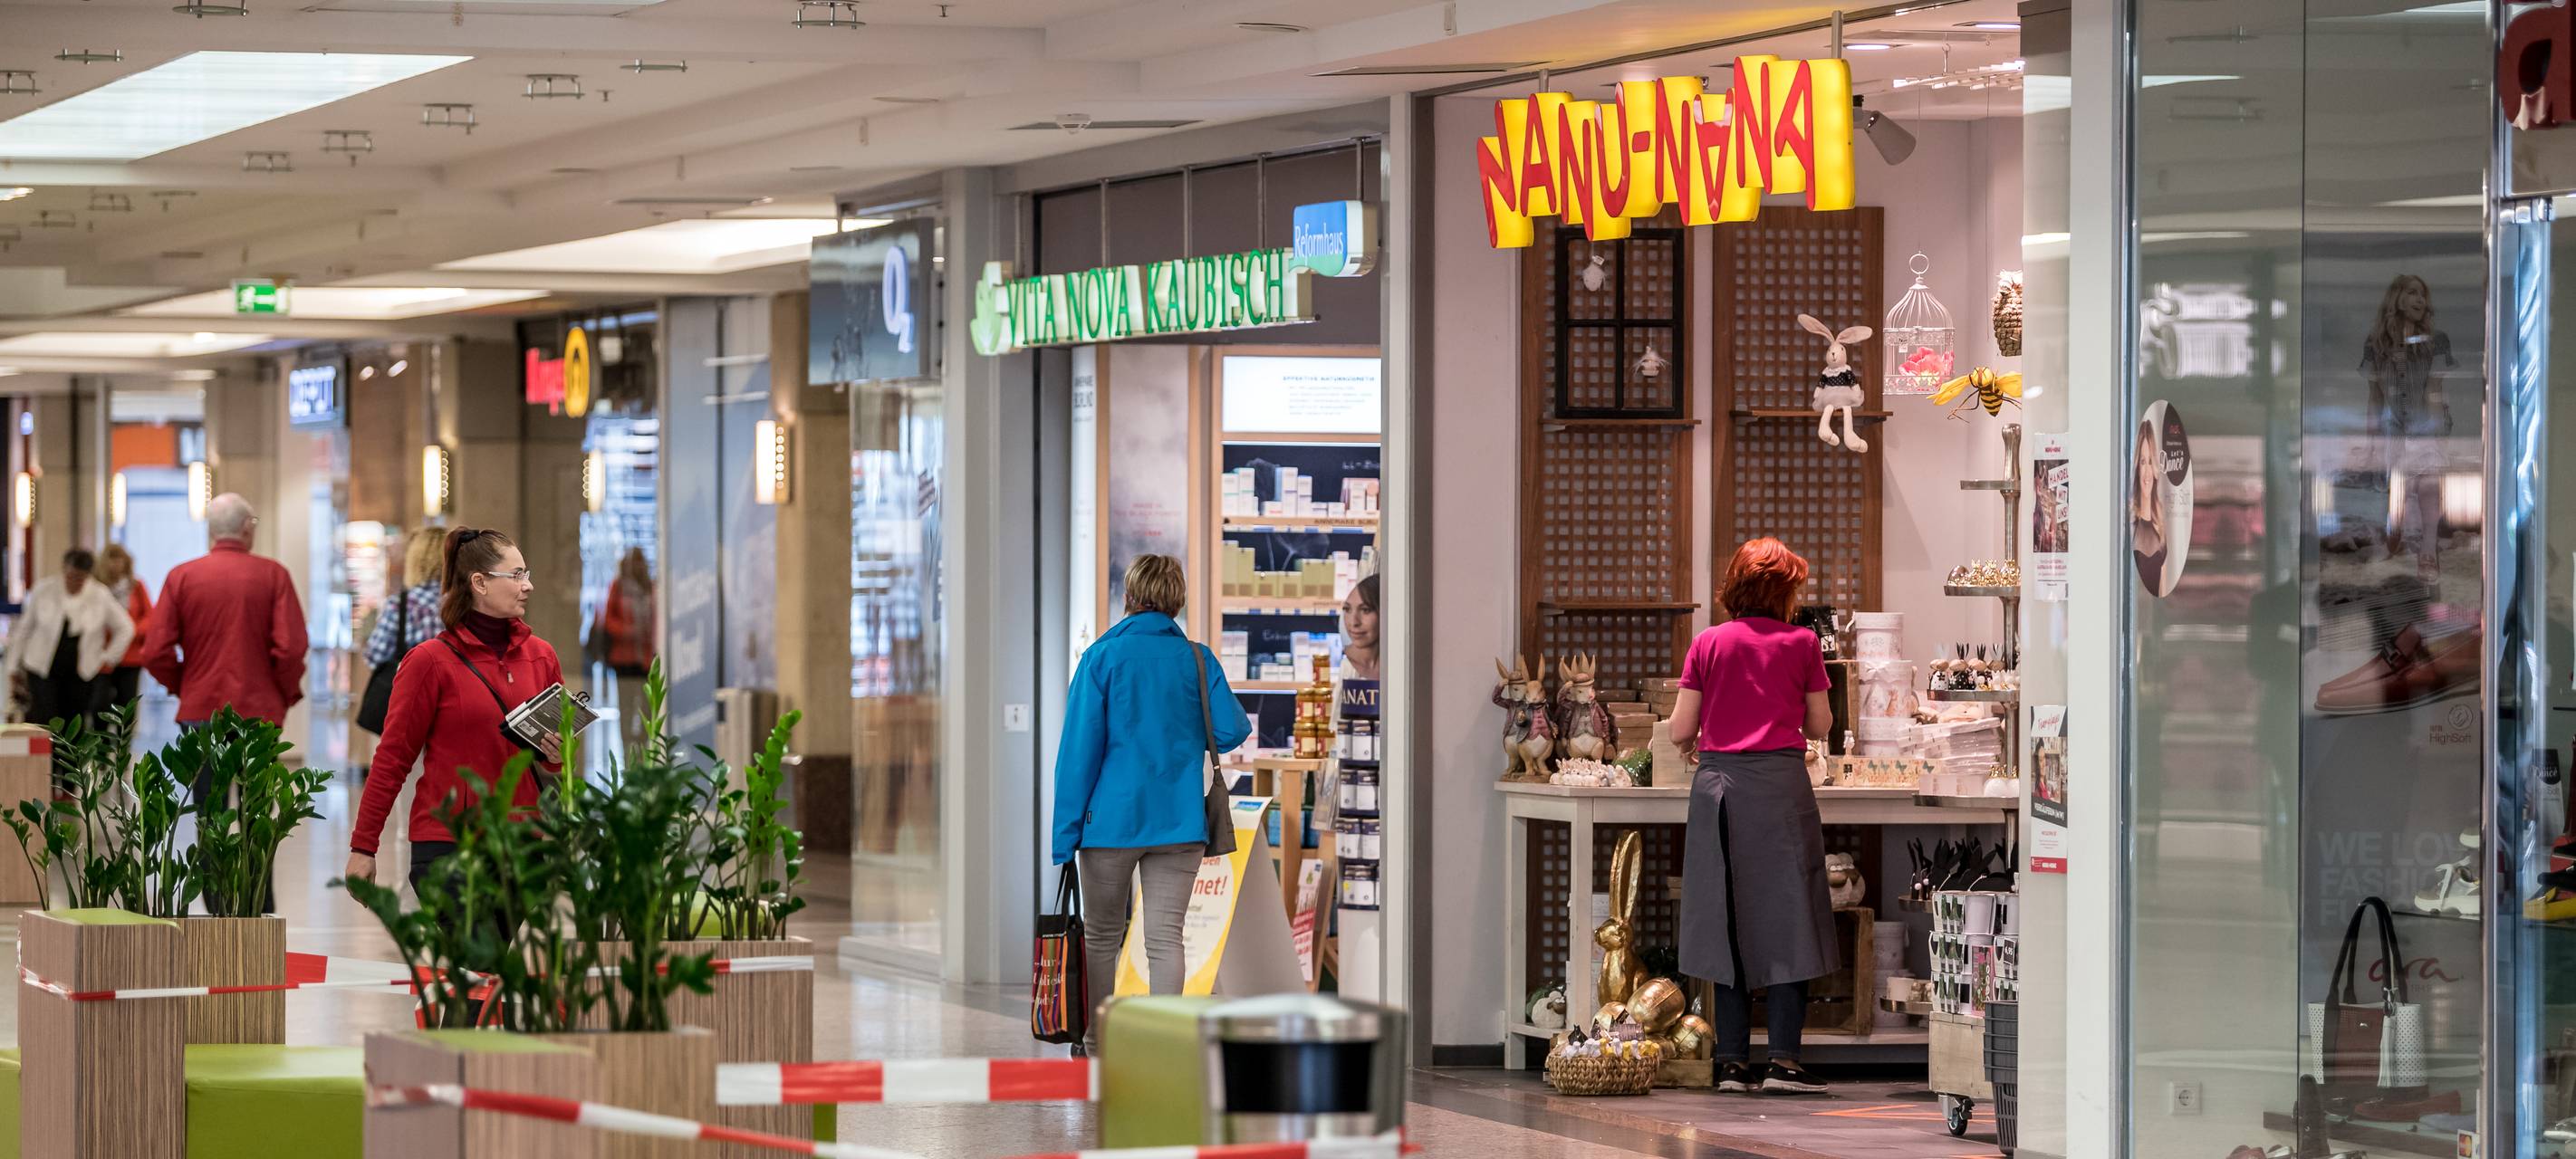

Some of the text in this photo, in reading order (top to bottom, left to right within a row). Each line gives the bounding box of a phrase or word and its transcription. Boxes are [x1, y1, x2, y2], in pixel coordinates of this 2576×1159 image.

[1476, 55, 1816, 248] NANU-NANA
[1294, 223, 1344, 266] Reformhaus
[1005, 247, 1286, 347] VITA NOVA KAUBISCH
[2159, 450, 2185, 474] Dance
[2318, 831, 2383, 866] WE
